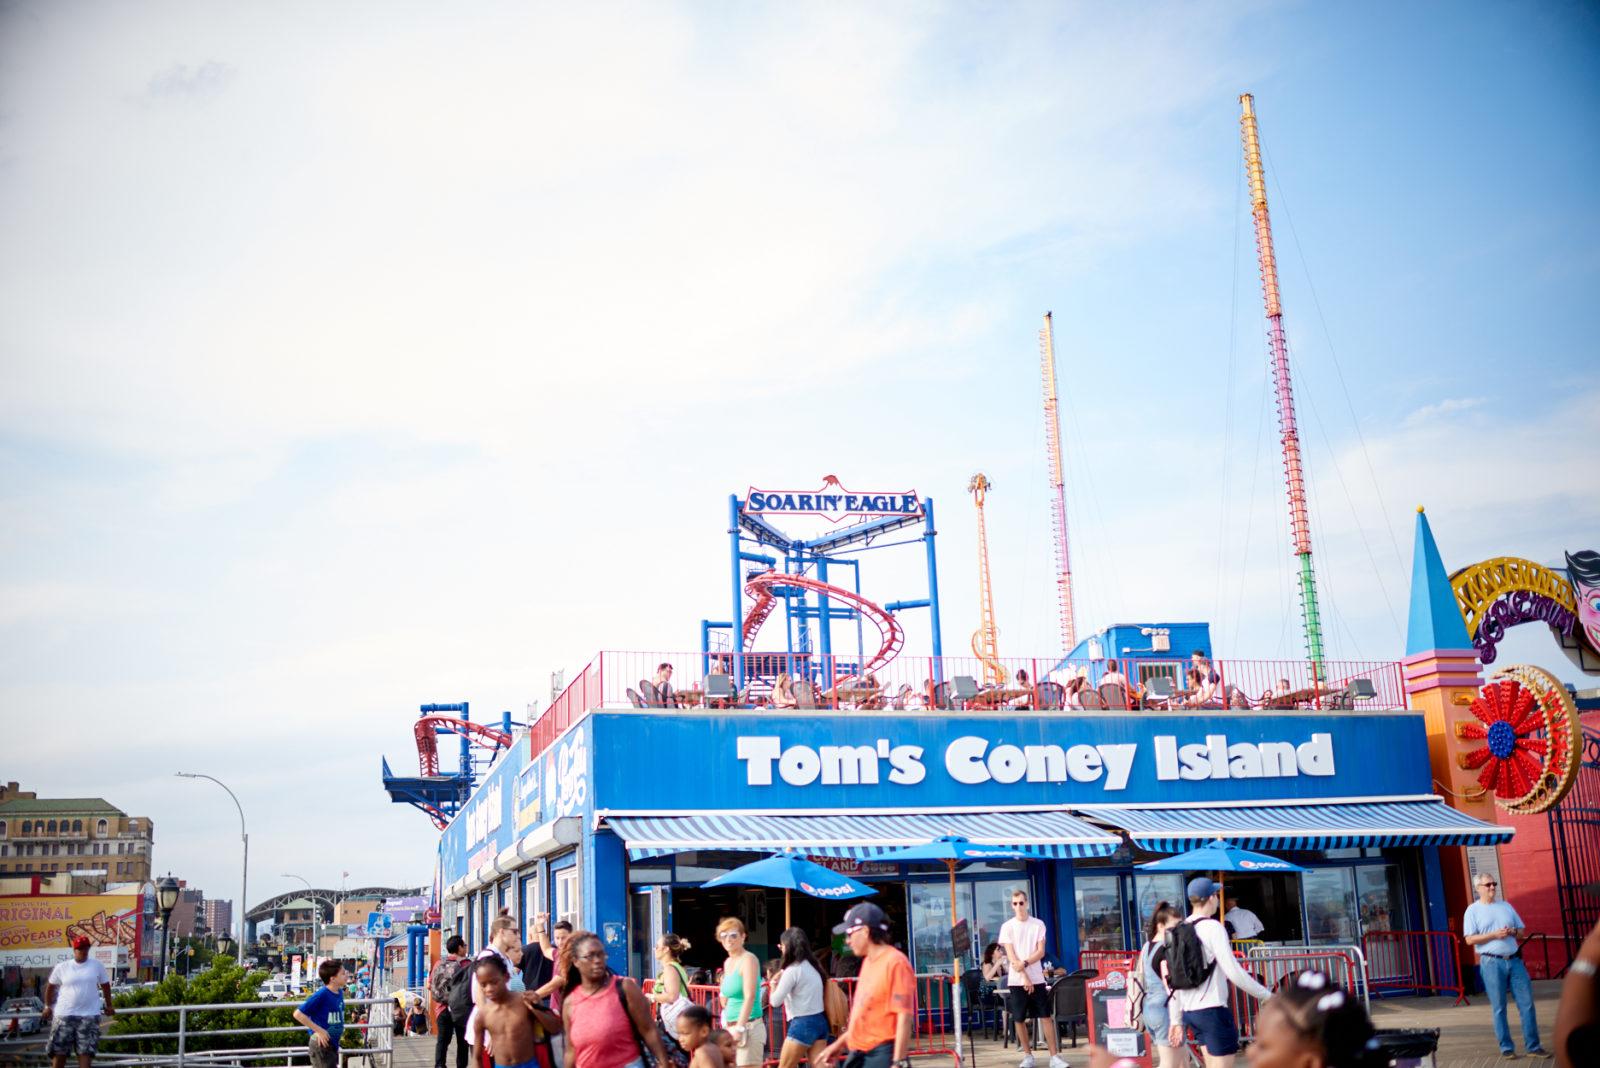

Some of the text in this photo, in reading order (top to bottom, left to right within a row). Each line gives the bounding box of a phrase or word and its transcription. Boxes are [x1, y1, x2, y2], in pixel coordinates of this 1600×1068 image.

[749, 492, 919, 513] SOARIN' EAGLE
[736, 733, 1336, 791] Tom's Coney Island
